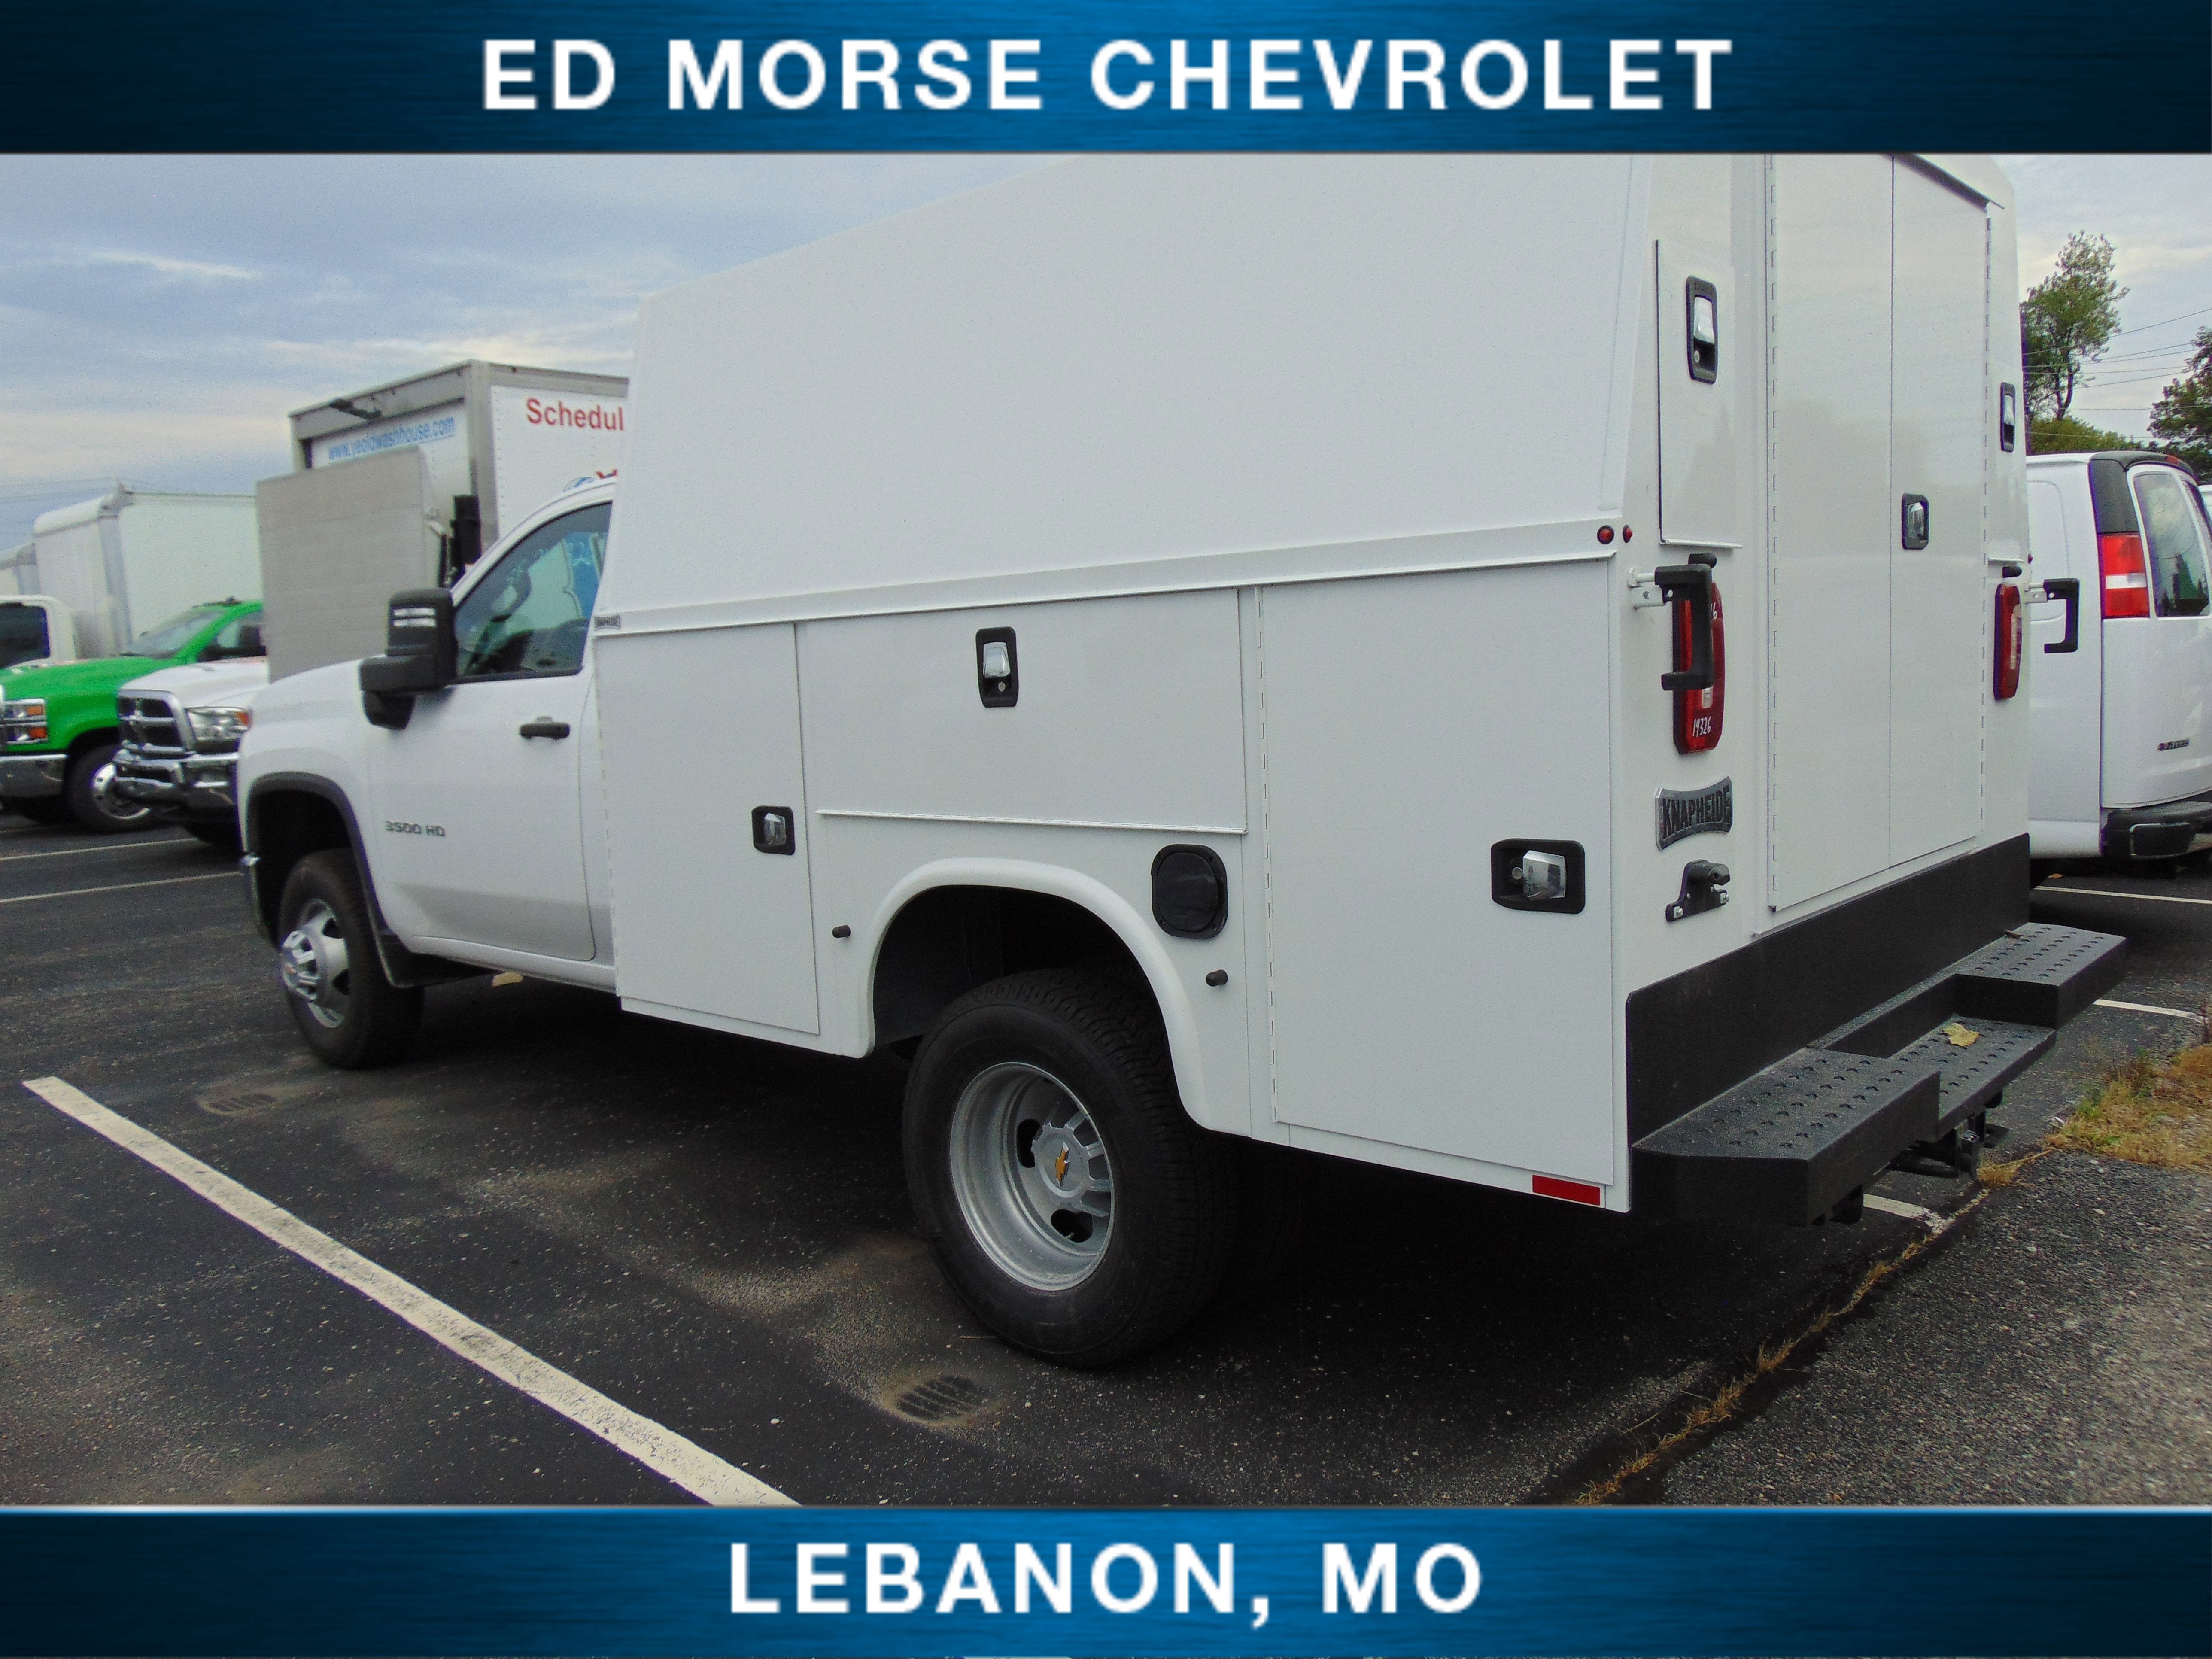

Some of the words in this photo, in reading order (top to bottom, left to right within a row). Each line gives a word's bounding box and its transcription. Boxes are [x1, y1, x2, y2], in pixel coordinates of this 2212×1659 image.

[526, 398, 624, 431] Schedul
[1692, 715, 1712, 738] 19326
[1662, 785, 1731, 840] KNAPHEIDE
[385, 820, 422, 834] 3500
[425, 824, 446, 837] HD
